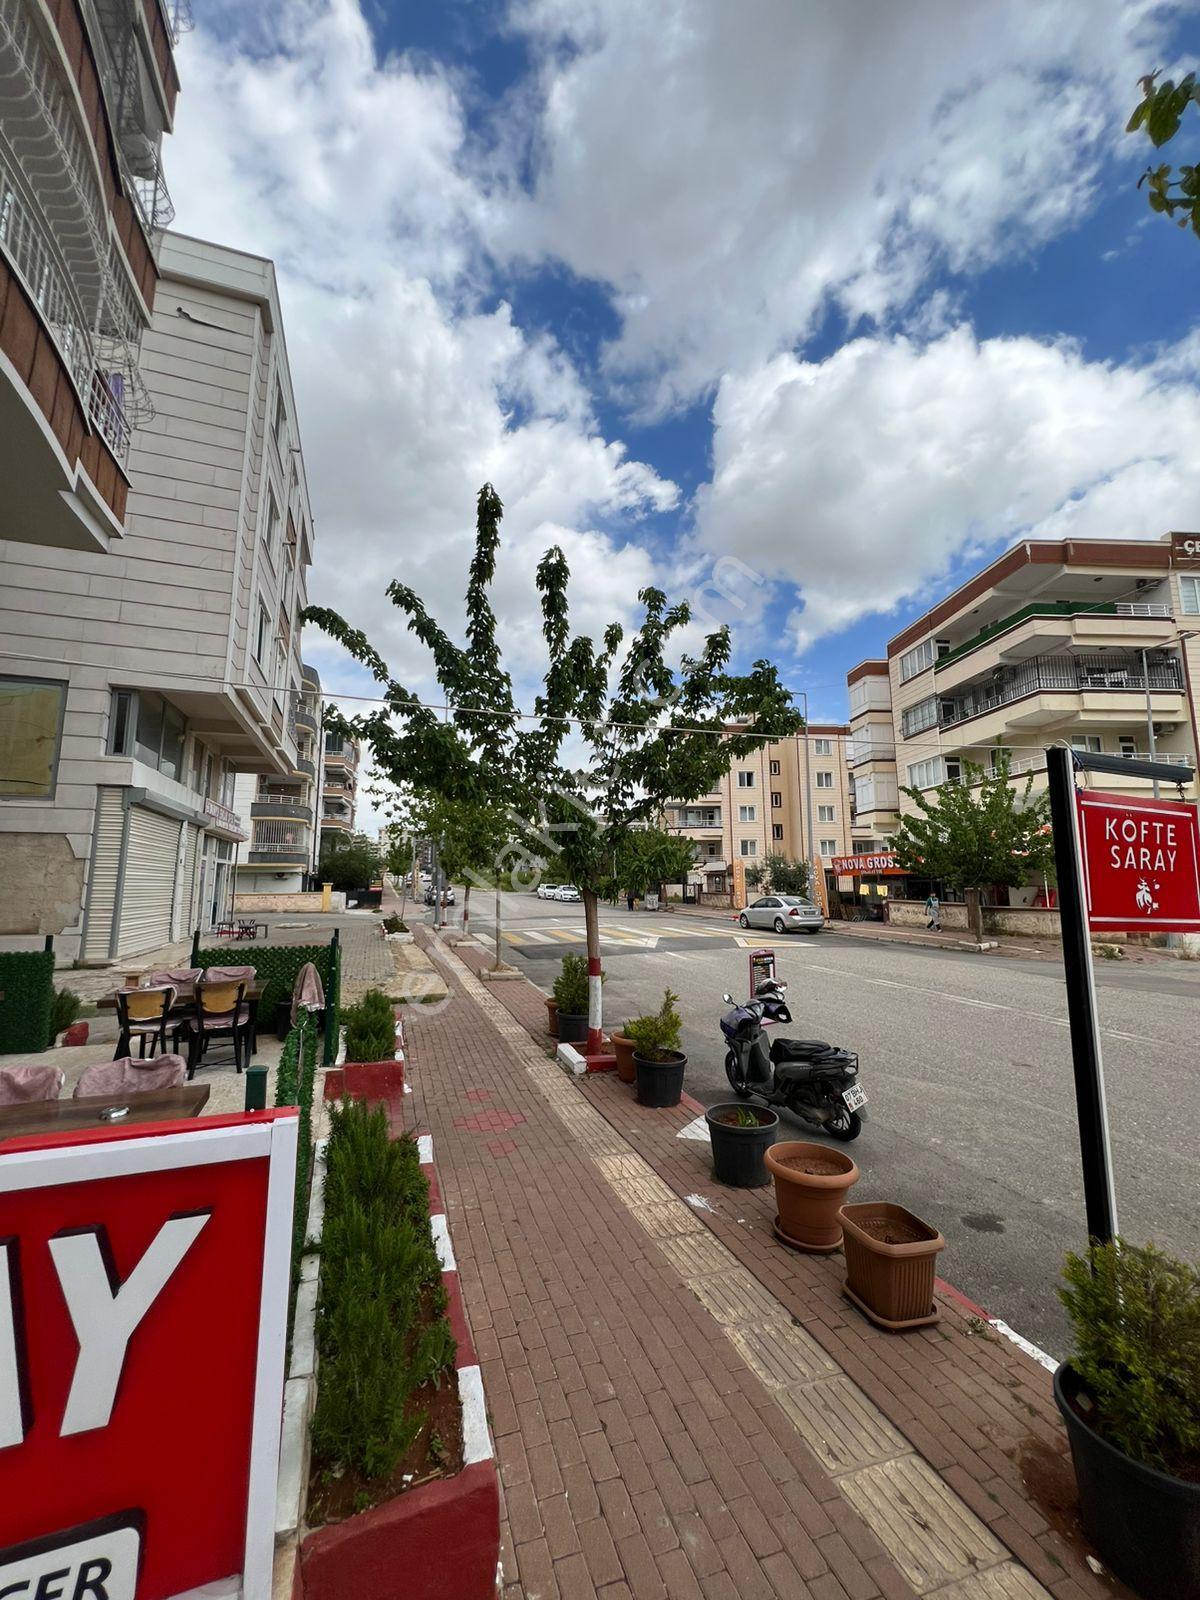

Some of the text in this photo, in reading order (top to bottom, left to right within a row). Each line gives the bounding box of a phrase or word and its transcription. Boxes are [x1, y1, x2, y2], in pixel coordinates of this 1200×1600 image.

[1105, 813, 1177, 846] KÖFTE
[842, 858, 866, 870] NOVA
[1110, 844, 1177, 872] SARAY
